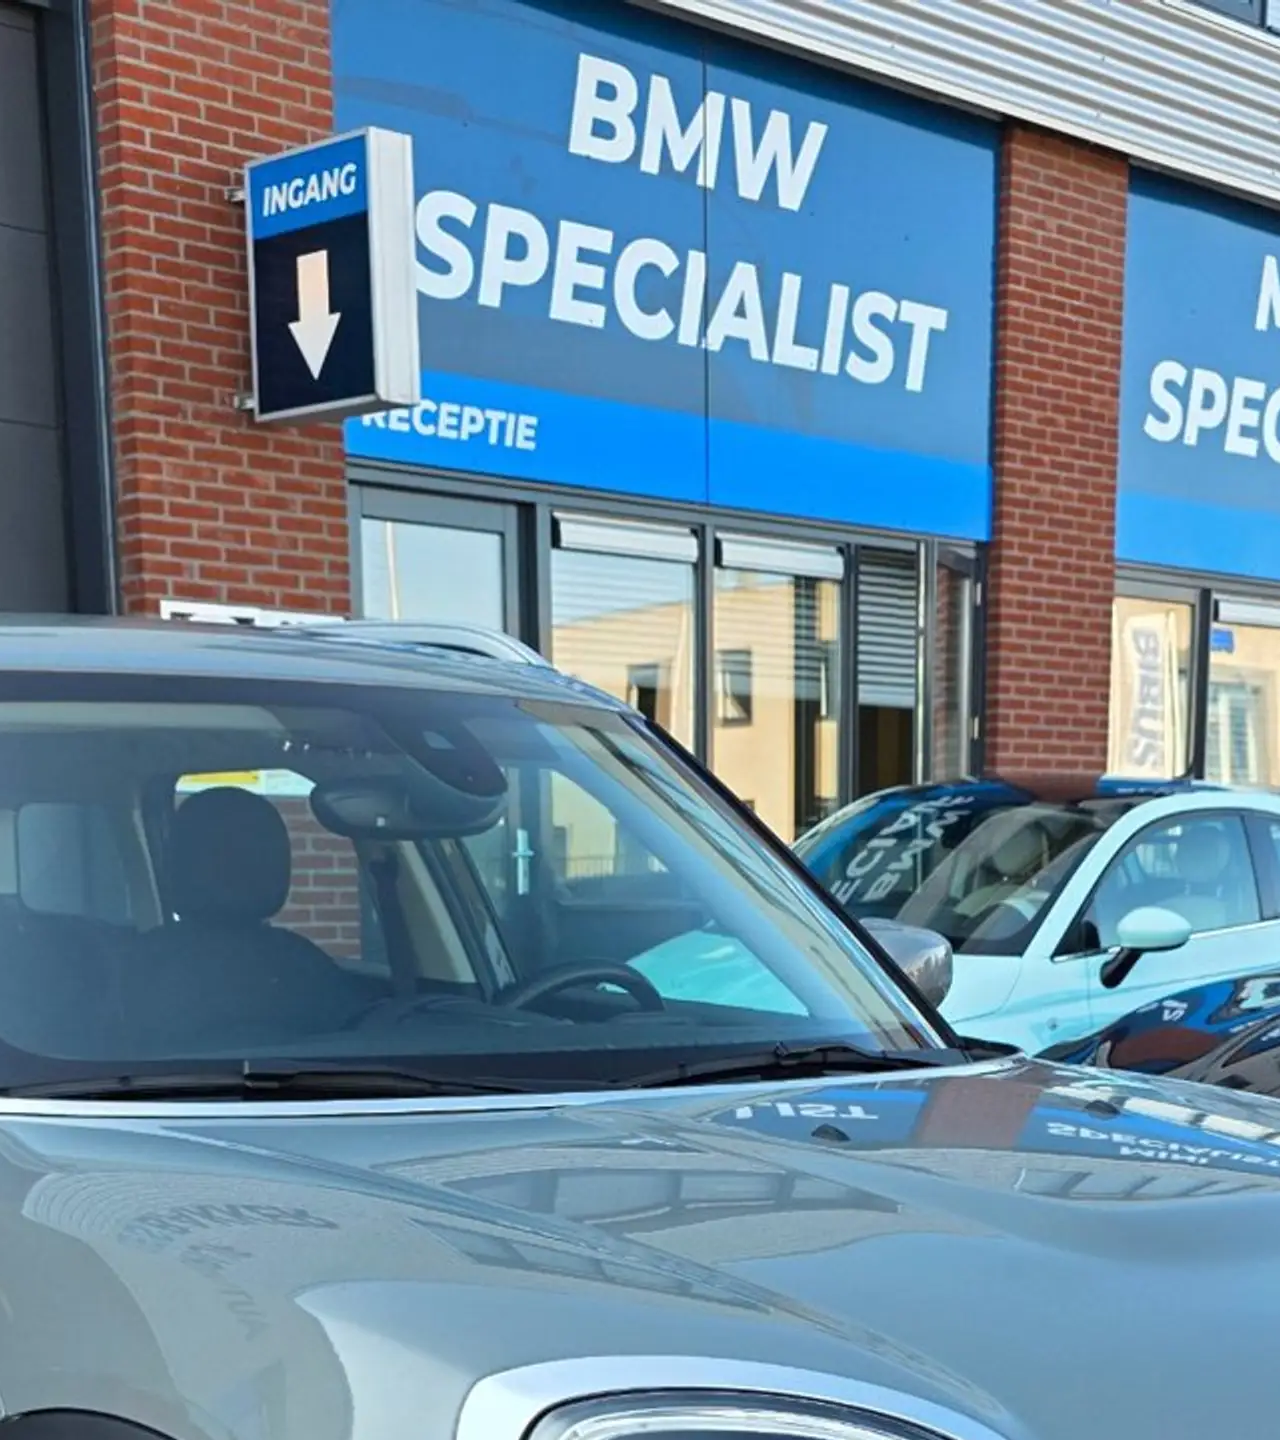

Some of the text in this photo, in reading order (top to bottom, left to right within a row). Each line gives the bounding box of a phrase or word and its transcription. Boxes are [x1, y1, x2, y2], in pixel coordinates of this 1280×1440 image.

[262, 162, 357, 217] INGANG
[569, 53, 828, 212] BMW
[416, 190, 948, 392] SPECIALIST
